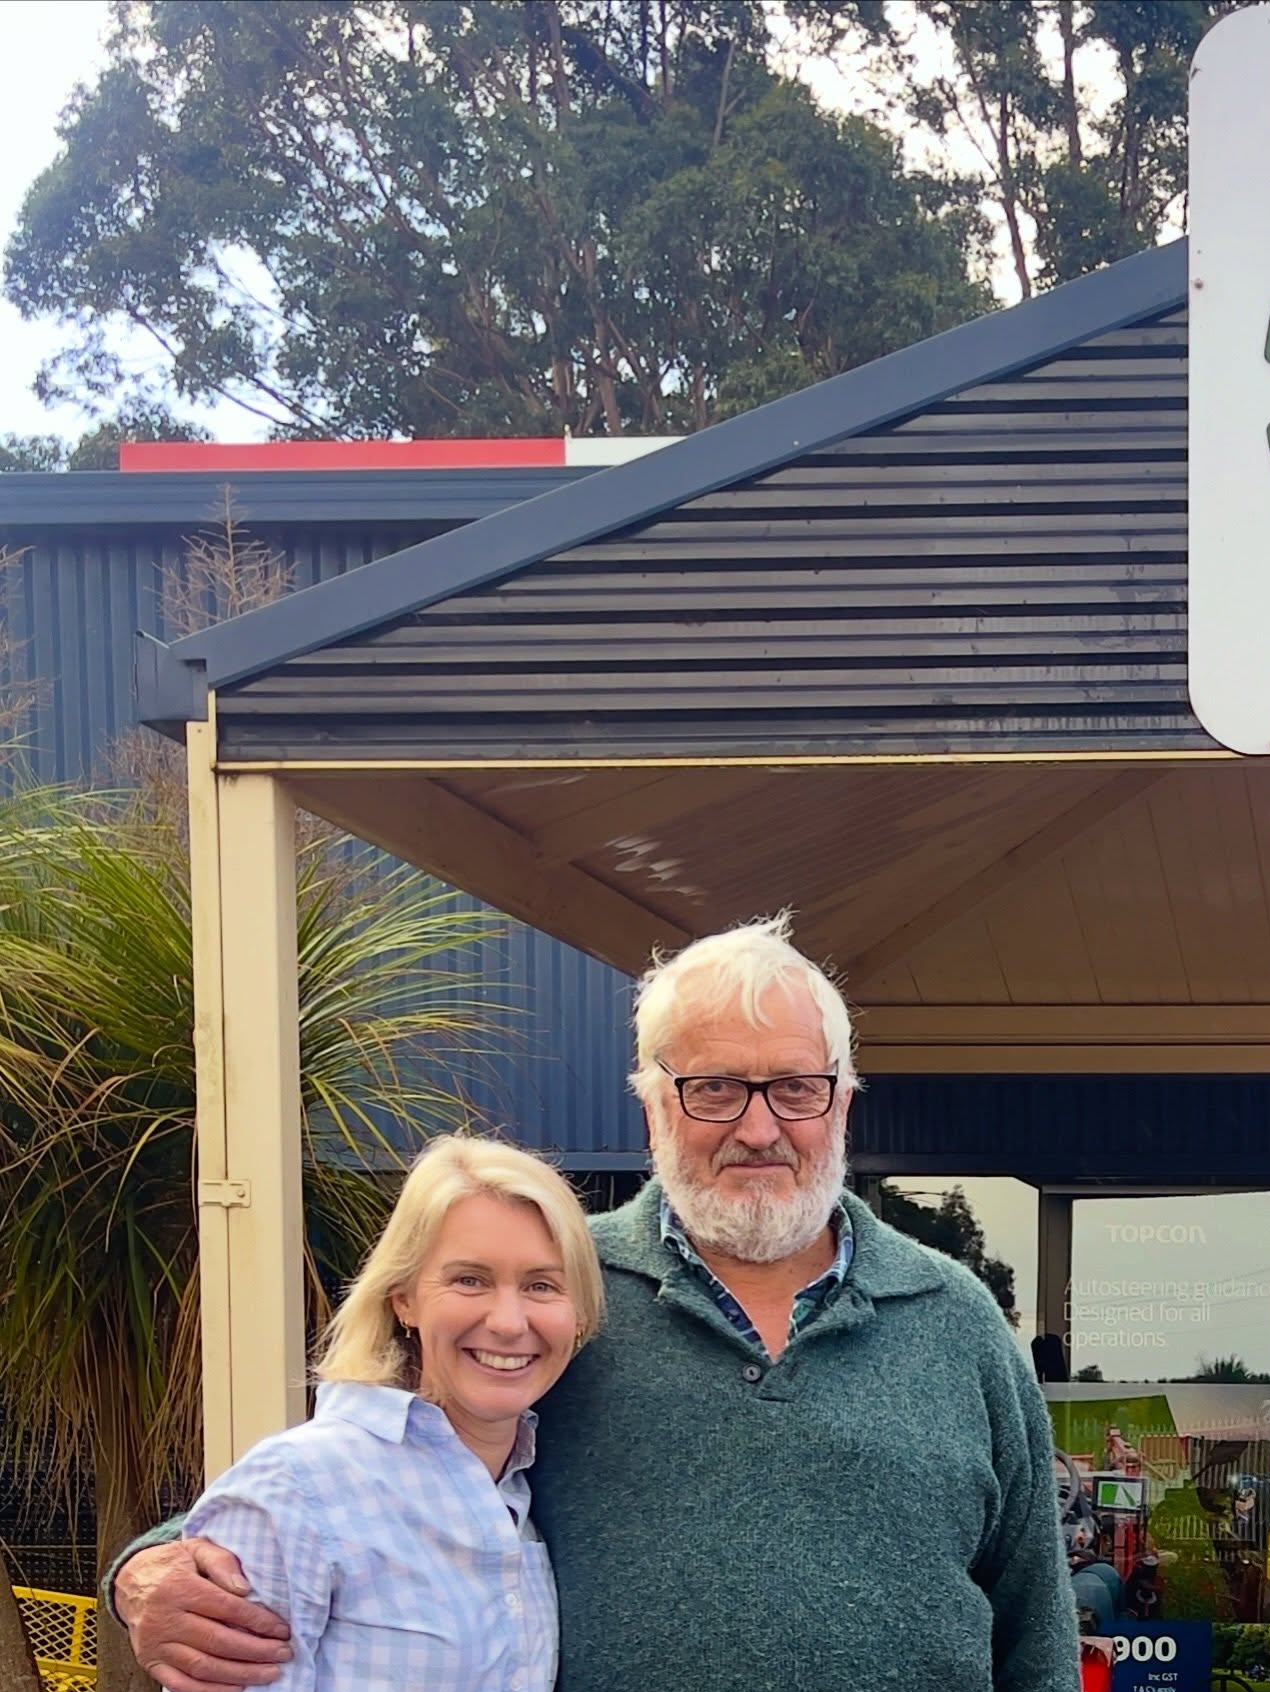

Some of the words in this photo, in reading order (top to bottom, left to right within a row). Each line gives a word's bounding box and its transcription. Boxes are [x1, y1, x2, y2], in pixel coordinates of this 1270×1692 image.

[1063, 1302, 1153, 1325] Designed
[1159, 1302, 1185, 1321] for
[1190, 1303, 1211, 1321] all
[1063, 1328, 1166, 1350] operations
[1161, 1672, 1178, 1681] GST
